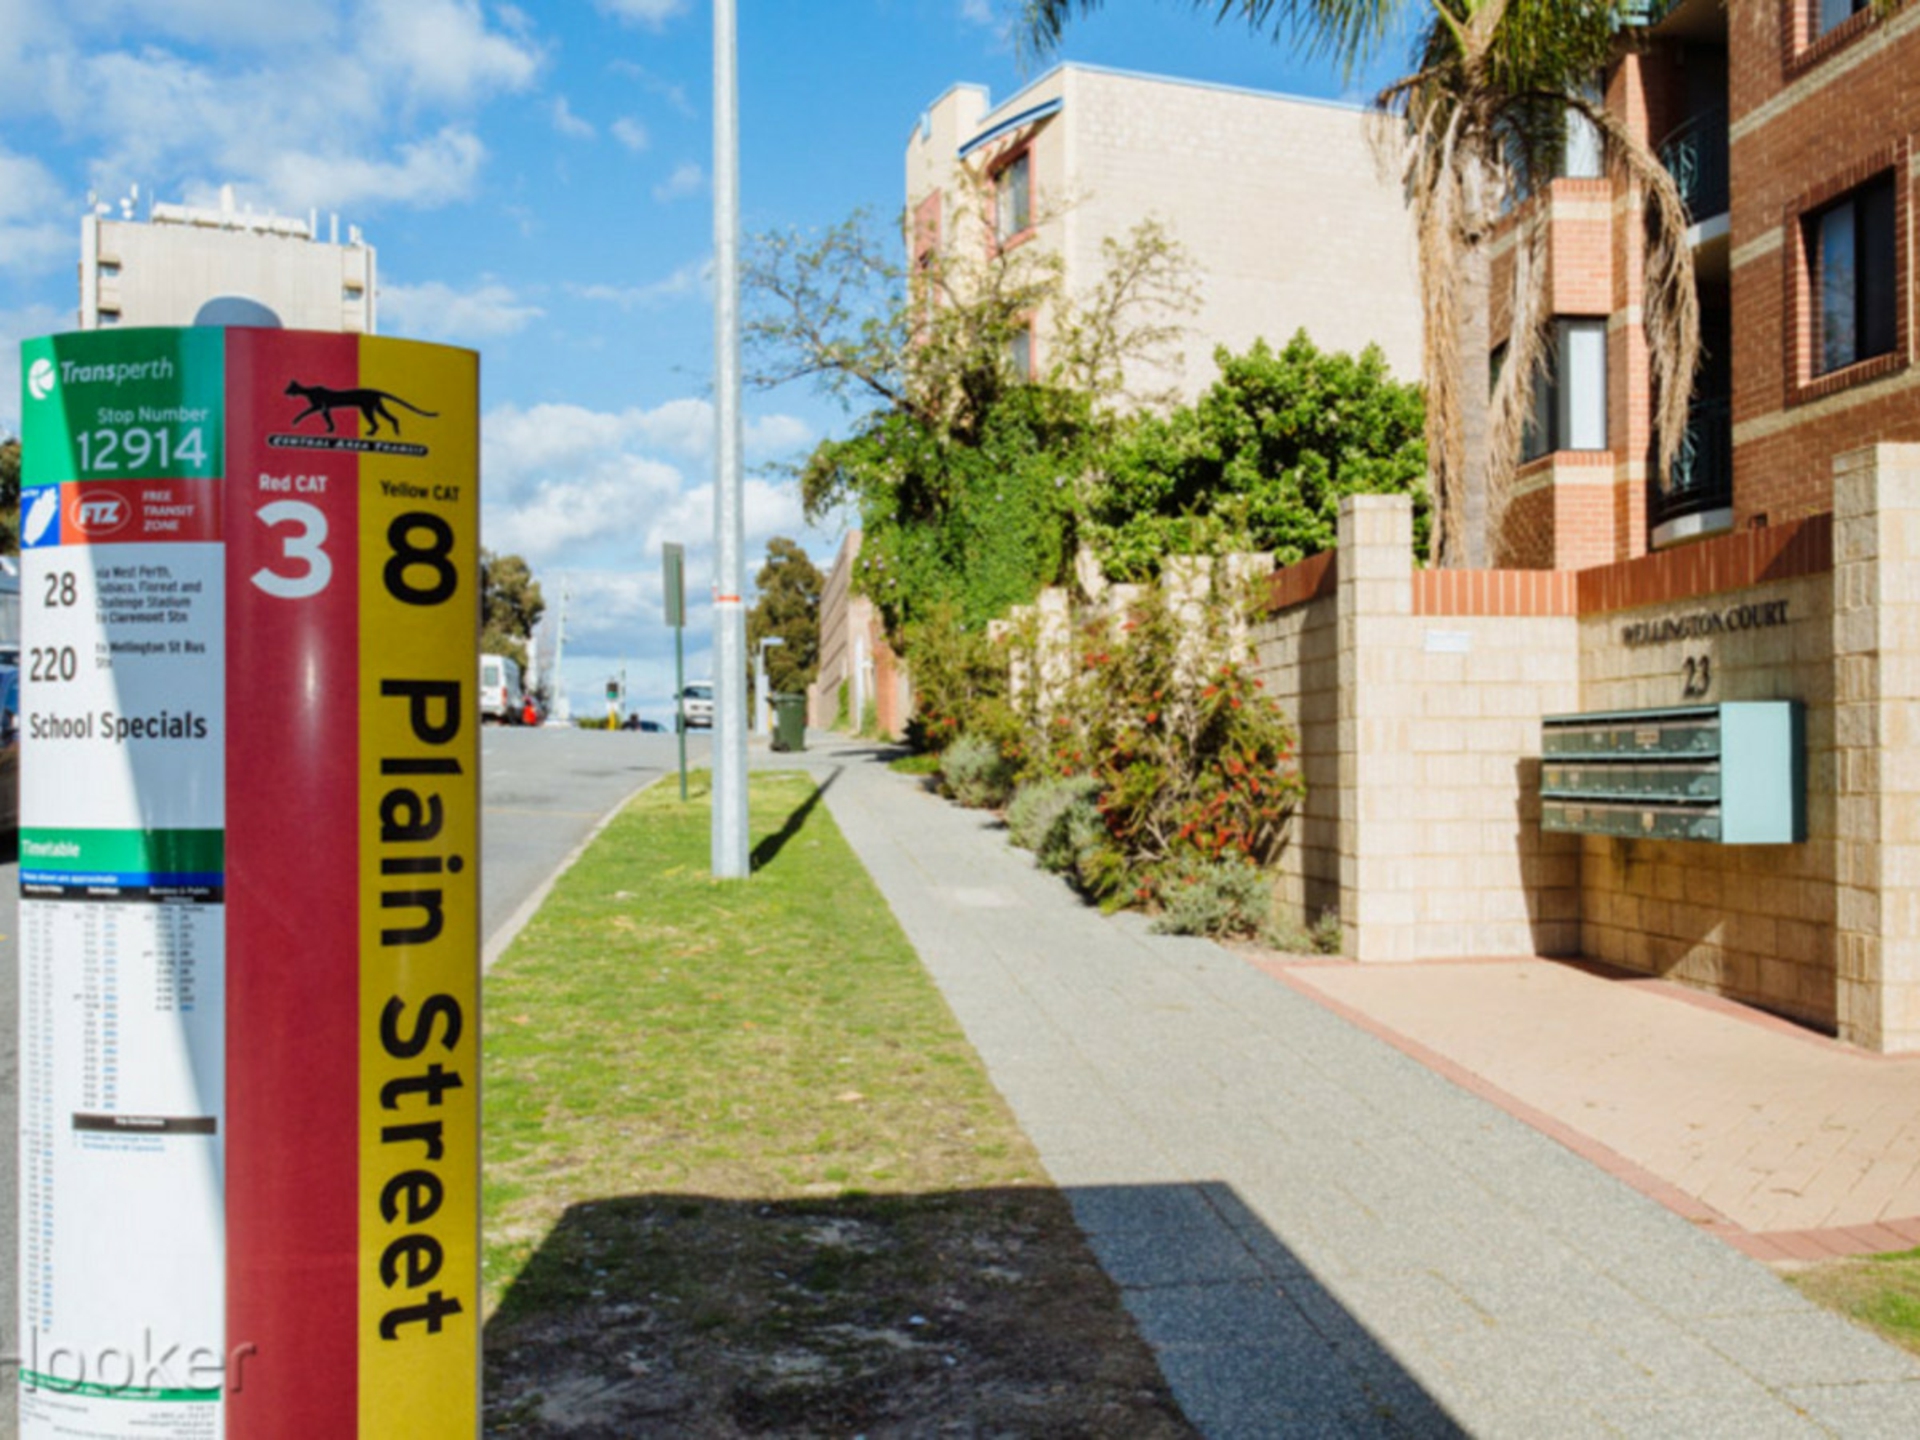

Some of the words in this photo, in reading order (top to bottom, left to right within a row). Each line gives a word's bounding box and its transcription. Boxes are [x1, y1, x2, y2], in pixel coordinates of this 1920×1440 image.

[60, 356, 174, 386] Transperth
[97, 407, 134, 424] Stop
[138, 405, 209, 422] Number
[76, 427, 207, 471] 12914
[273, 435, 329, 447] CENTRAL
[336, 439, 369, 449] AREA
[259, 473, 291, 491] Red
[295, 475, 327, 492] CAT
[380, 480, 428, 498] Yellow
[433, 485, 459, 501] CAT
[142, 490, 172, 502] FREE
[79, 501, 120, 525] FTZ
[143, 505, 195, 516] TRANSIT
[143, 520, 179, 532] ZONE
[250, 499, 333, 599] 3
[382, 510, 459, 607] 8
[112, 566, 136, 578] West
[44, 571, 77, 608] 28
[139, 581, 178, 593] Floreat
[182, 581, 202, 593] and
[147, 596, 191, 608] Stadium
[109, 611, 164, 623] Claremont
[1622, 609, 1724, 645] WELLINGTON
[1725, 600, 1789, 632] COURT
[109, 642, 165, 655] Wellington
[168, 641, 181, 653] St
[185, 641, 205, 653] Bus
[30, 646, 77, 682] 220
[1682, 655, 1710, 698] 23
[30, 712, 93, 740] School
[100, 711, 208, 742] Specials
[379, 679, 464, 947] Plain
[22, 839, 80, 858] Timetable
[379, 993, 464, 1341] Street
